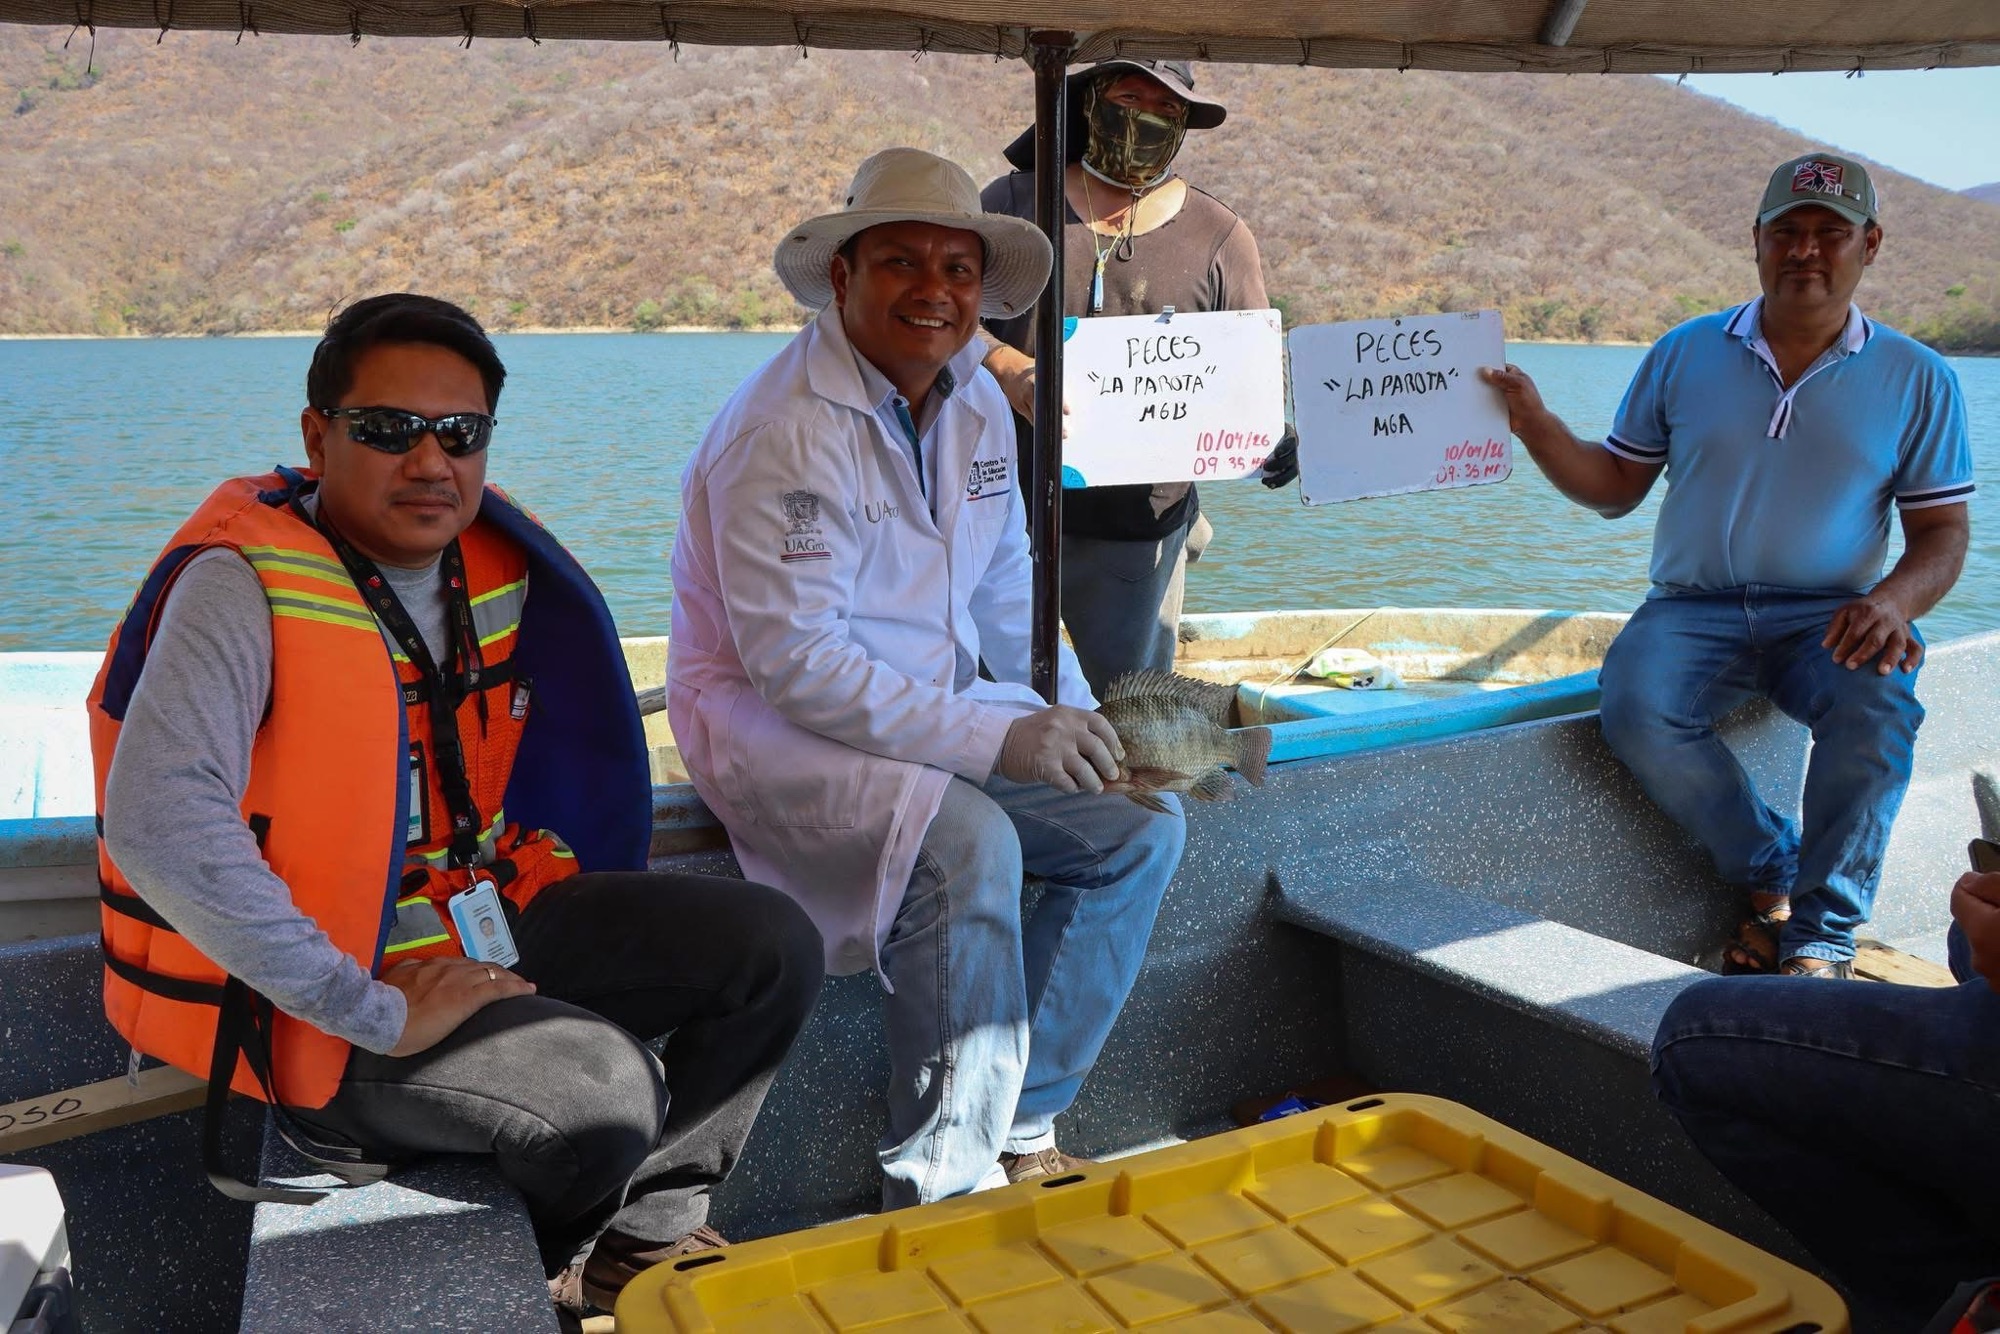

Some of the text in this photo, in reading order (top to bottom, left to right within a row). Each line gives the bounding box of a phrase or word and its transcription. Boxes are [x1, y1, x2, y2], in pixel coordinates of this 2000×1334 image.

[1126, 335, 1202, 369] PECES
[1356, 329, 1442, 364] PECES
[784, 538, 825, 553] UAGro
